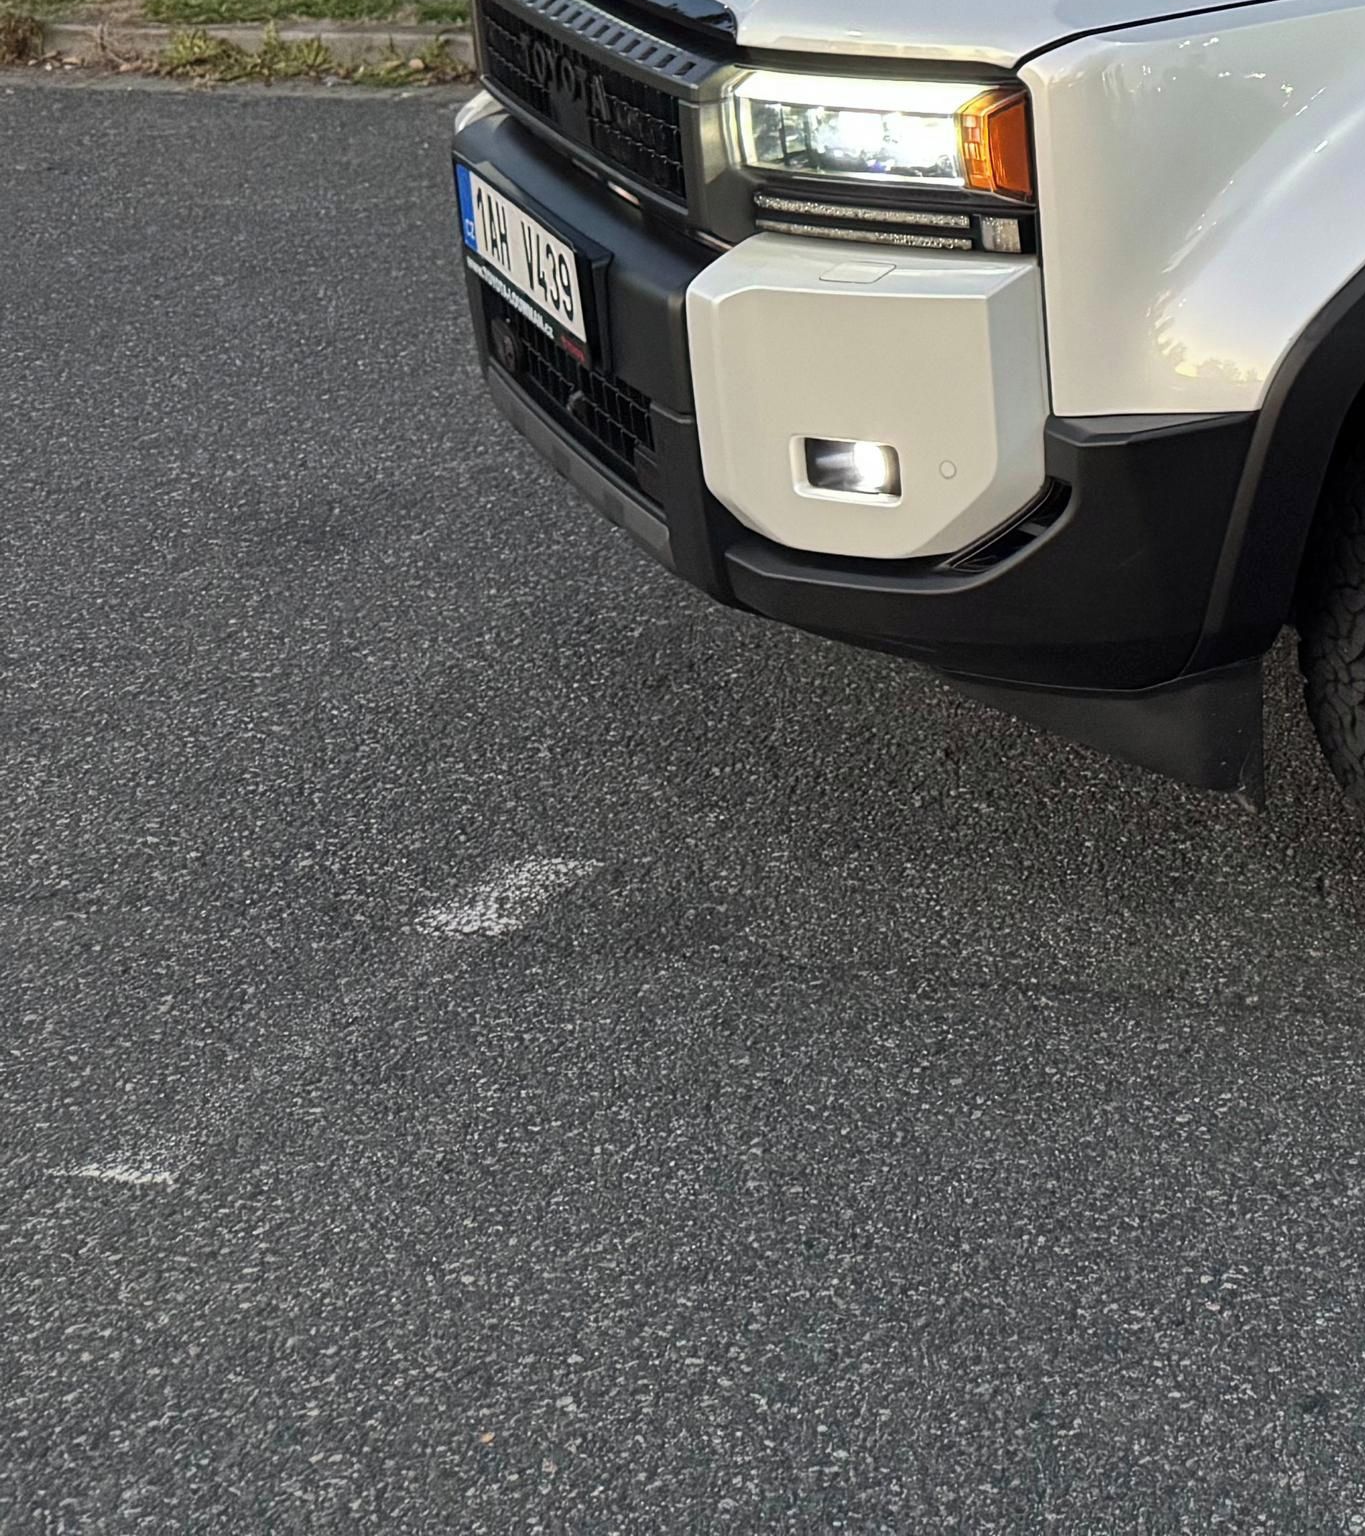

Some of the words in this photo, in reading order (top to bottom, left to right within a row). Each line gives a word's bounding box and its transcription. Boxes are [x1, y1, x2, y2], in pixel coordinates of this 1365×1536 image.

[519, 32, 611, 122] TOYOTA
[477, 187, 512, 272] 1AH
[520, 220, 574, 322] V439
